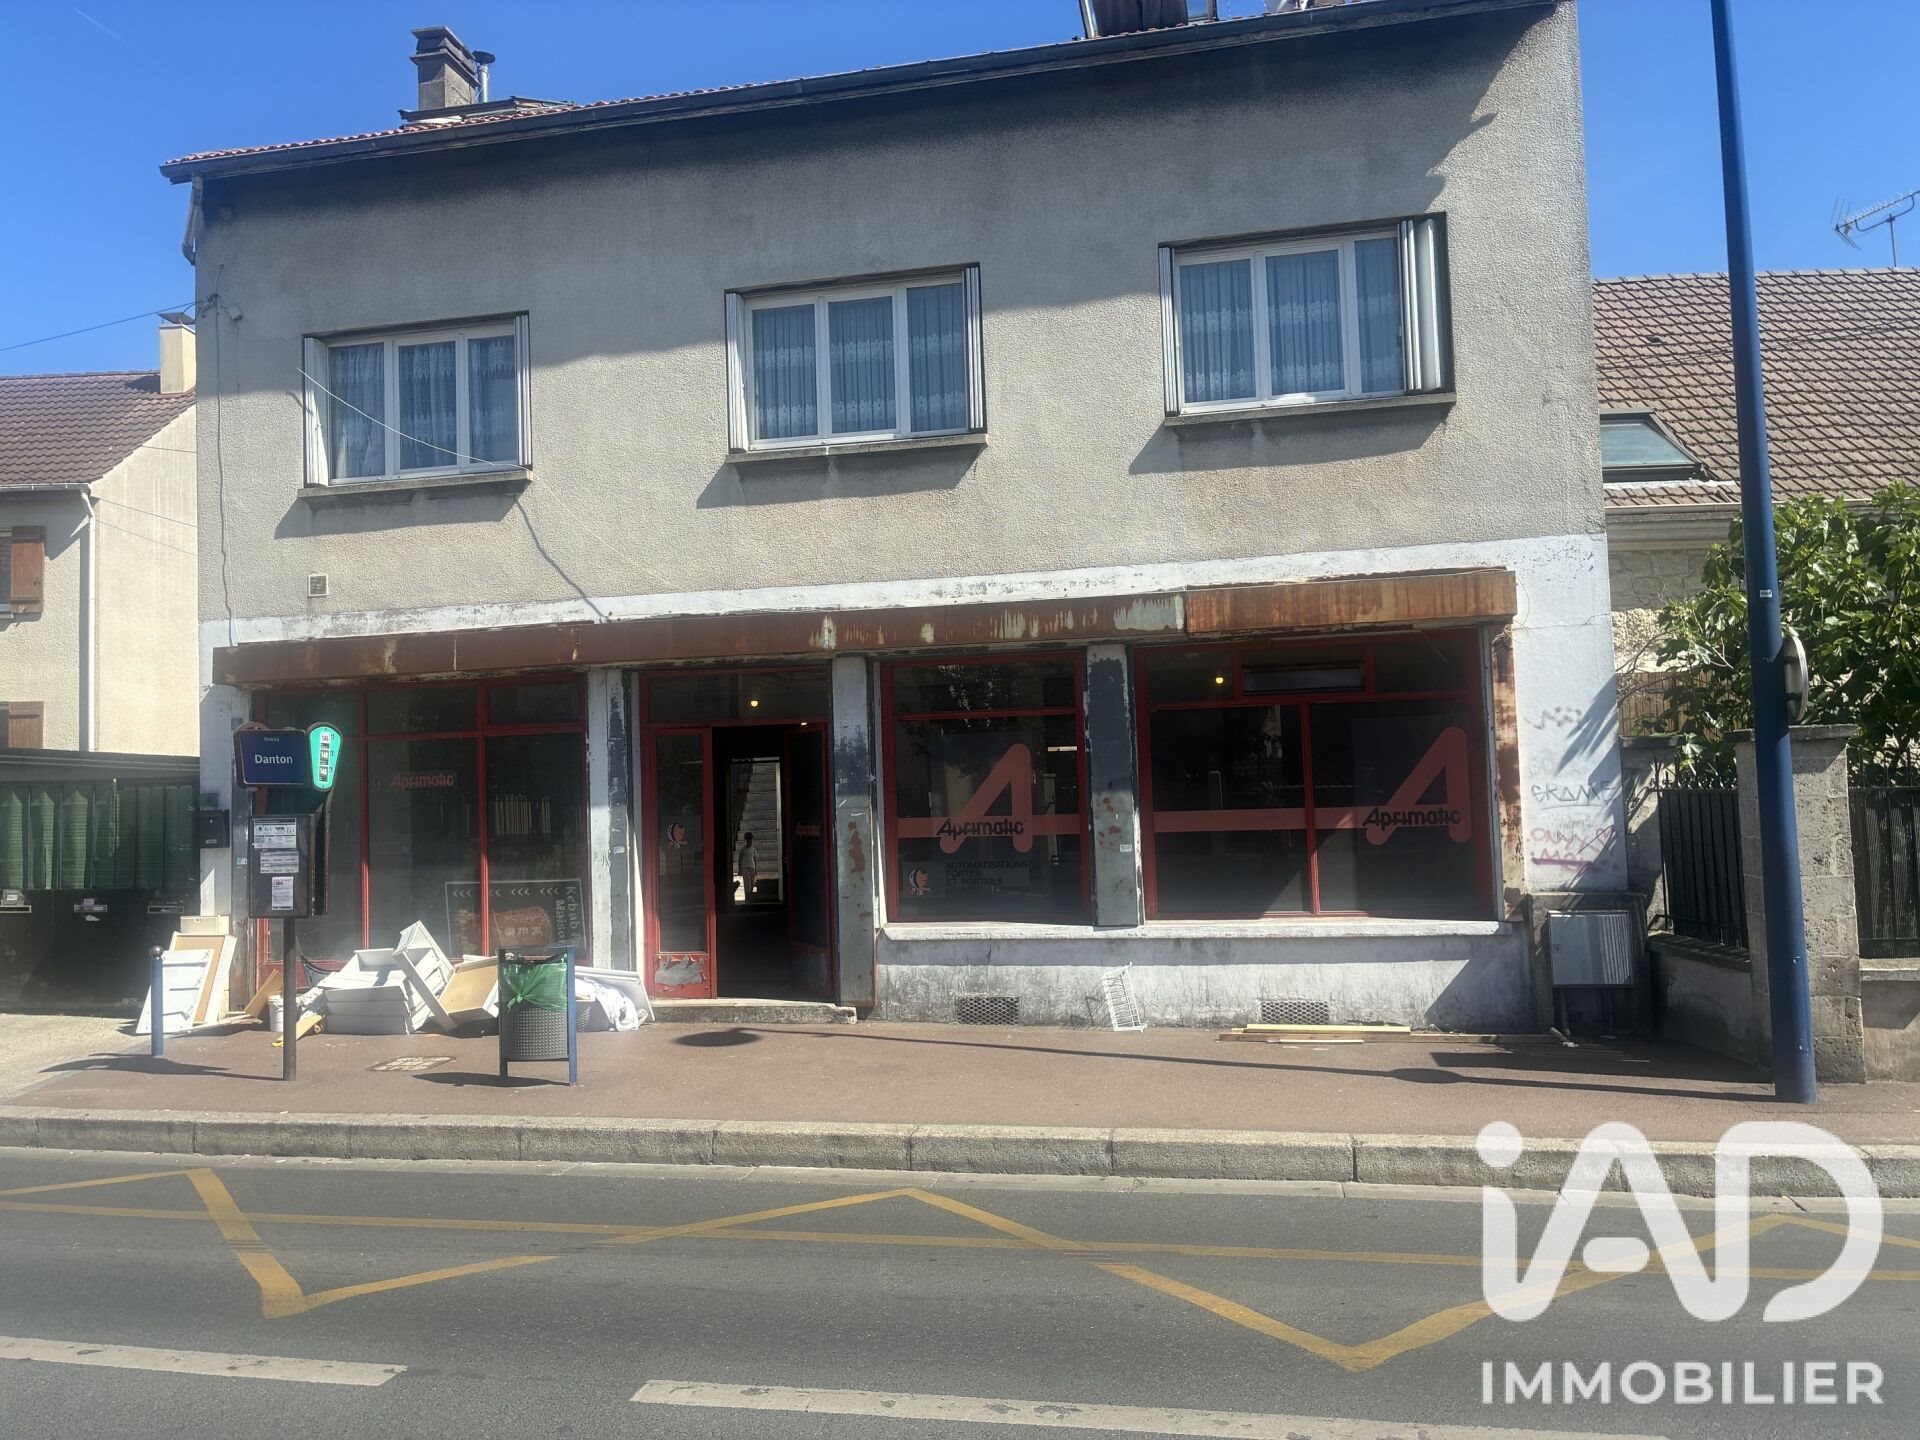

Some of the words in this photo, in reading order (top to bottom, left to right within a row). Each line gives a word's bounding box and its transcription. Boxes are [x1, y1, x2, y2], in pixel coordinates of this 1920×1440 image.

[254, 754, 293, 764] Danton
[936, 818, 1025, 840] Aprimatic
[1362, 806, 1461, 832] Aprimatic
[945, 860, 1028, 869] AUTOMATISATIONS
[566, 886, 580, 930] Kebab
